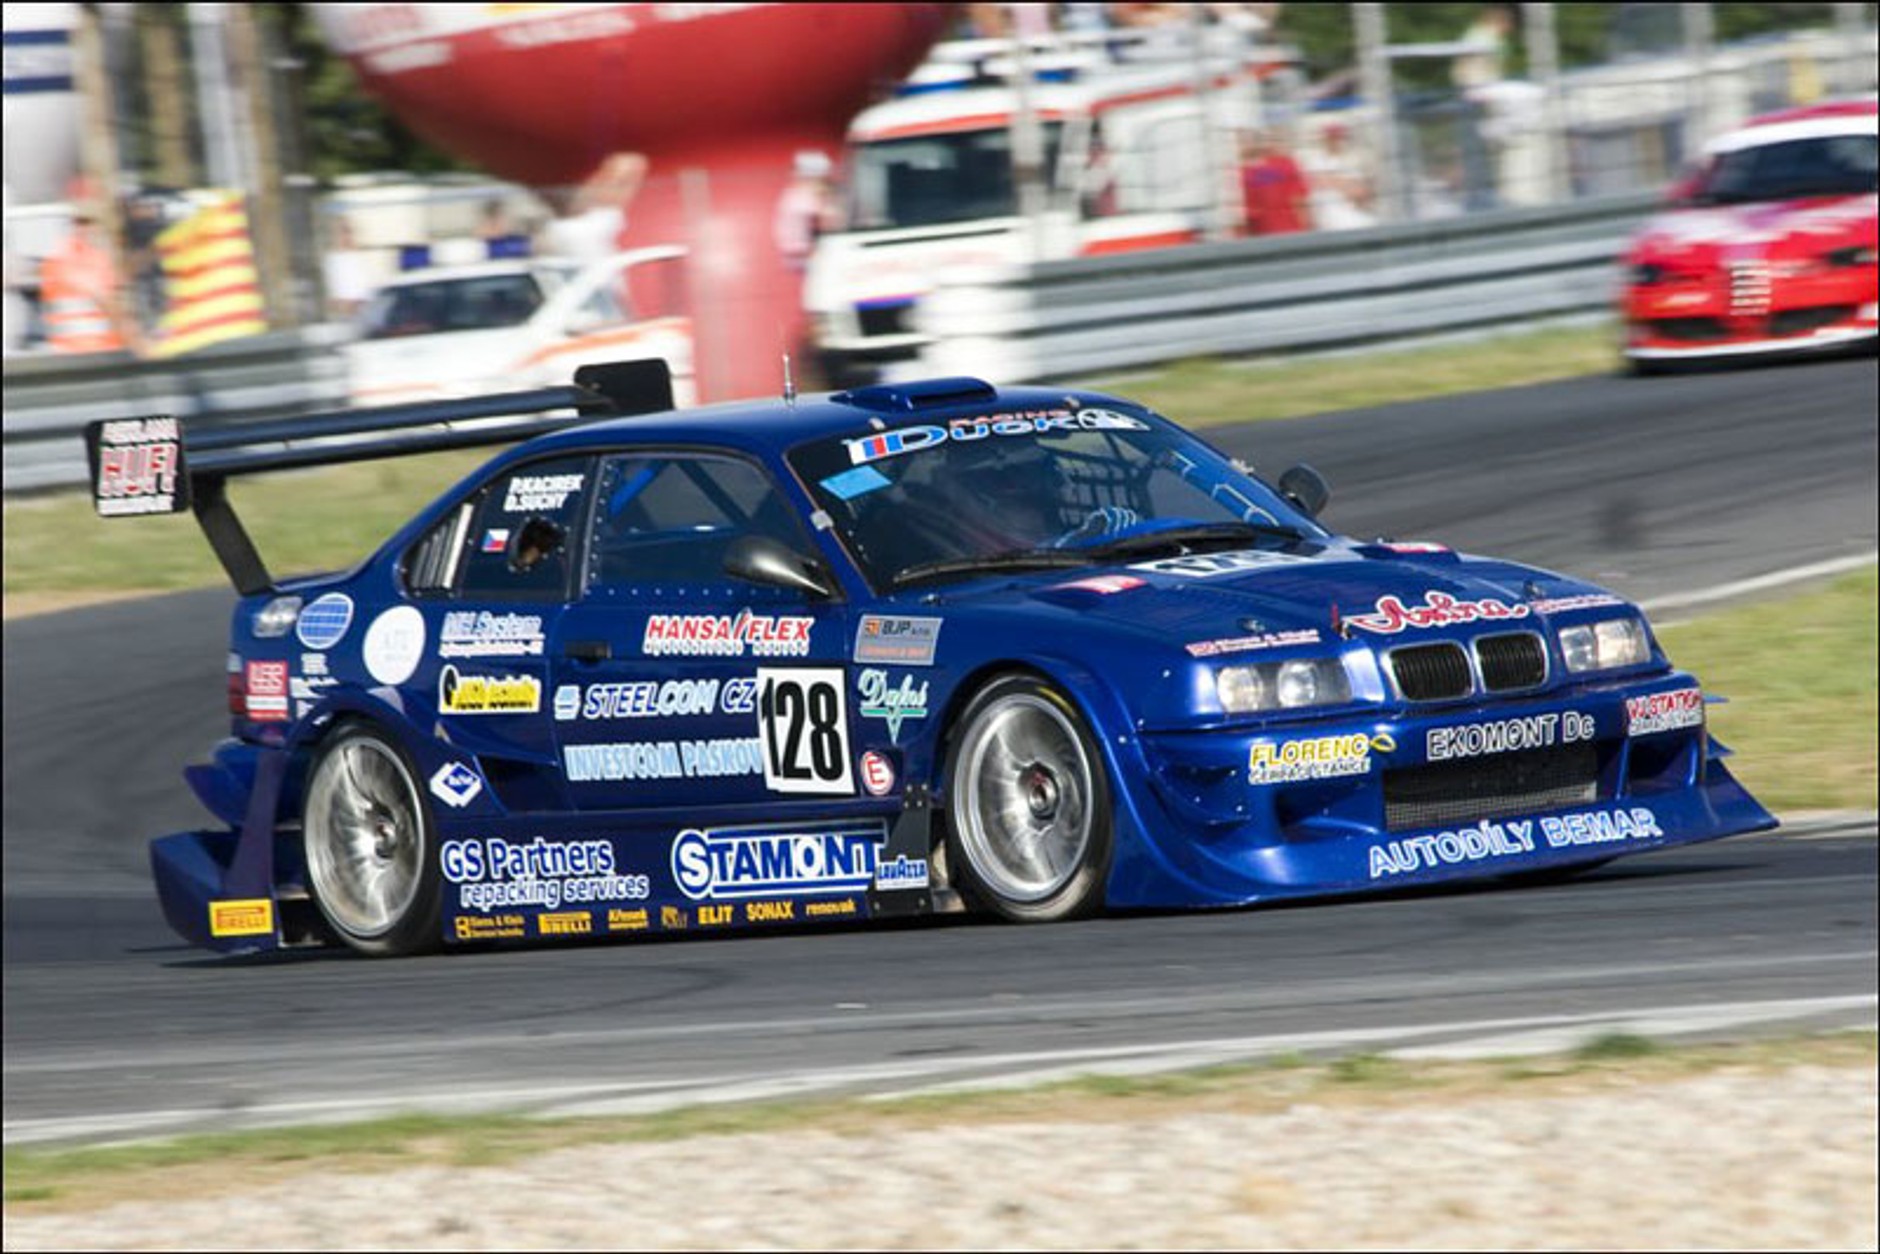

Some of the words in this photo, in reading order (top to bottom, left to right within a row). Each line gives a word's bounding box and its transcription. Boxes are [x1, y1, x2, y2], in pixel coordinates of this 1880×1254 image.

[583, 679, 720, 720] STEELCOM
[721, 678, 758, 714] CZ
[761, 677, 844, 782] 128
[1427, 714, 1560, 762] EKOMONT
[564, 742, 682, 782] INVESTCOM
[1250, 733, 1370, 769] FLORENC
[440, 840, 485, 882] GS
[487, 837, 615, 880] Partners
[676, 834, 880, 886] STAMONT
[1369, 818, 1536, 879] AUTODÍLY
[1539, 807, 1664, 848] BEMAR
[461, 878, 561, 912] repacking
[563, 874, 650, 904] services
[746, 901, 796, 921] SONAX
[697, 905, 734, 925] ELIT
